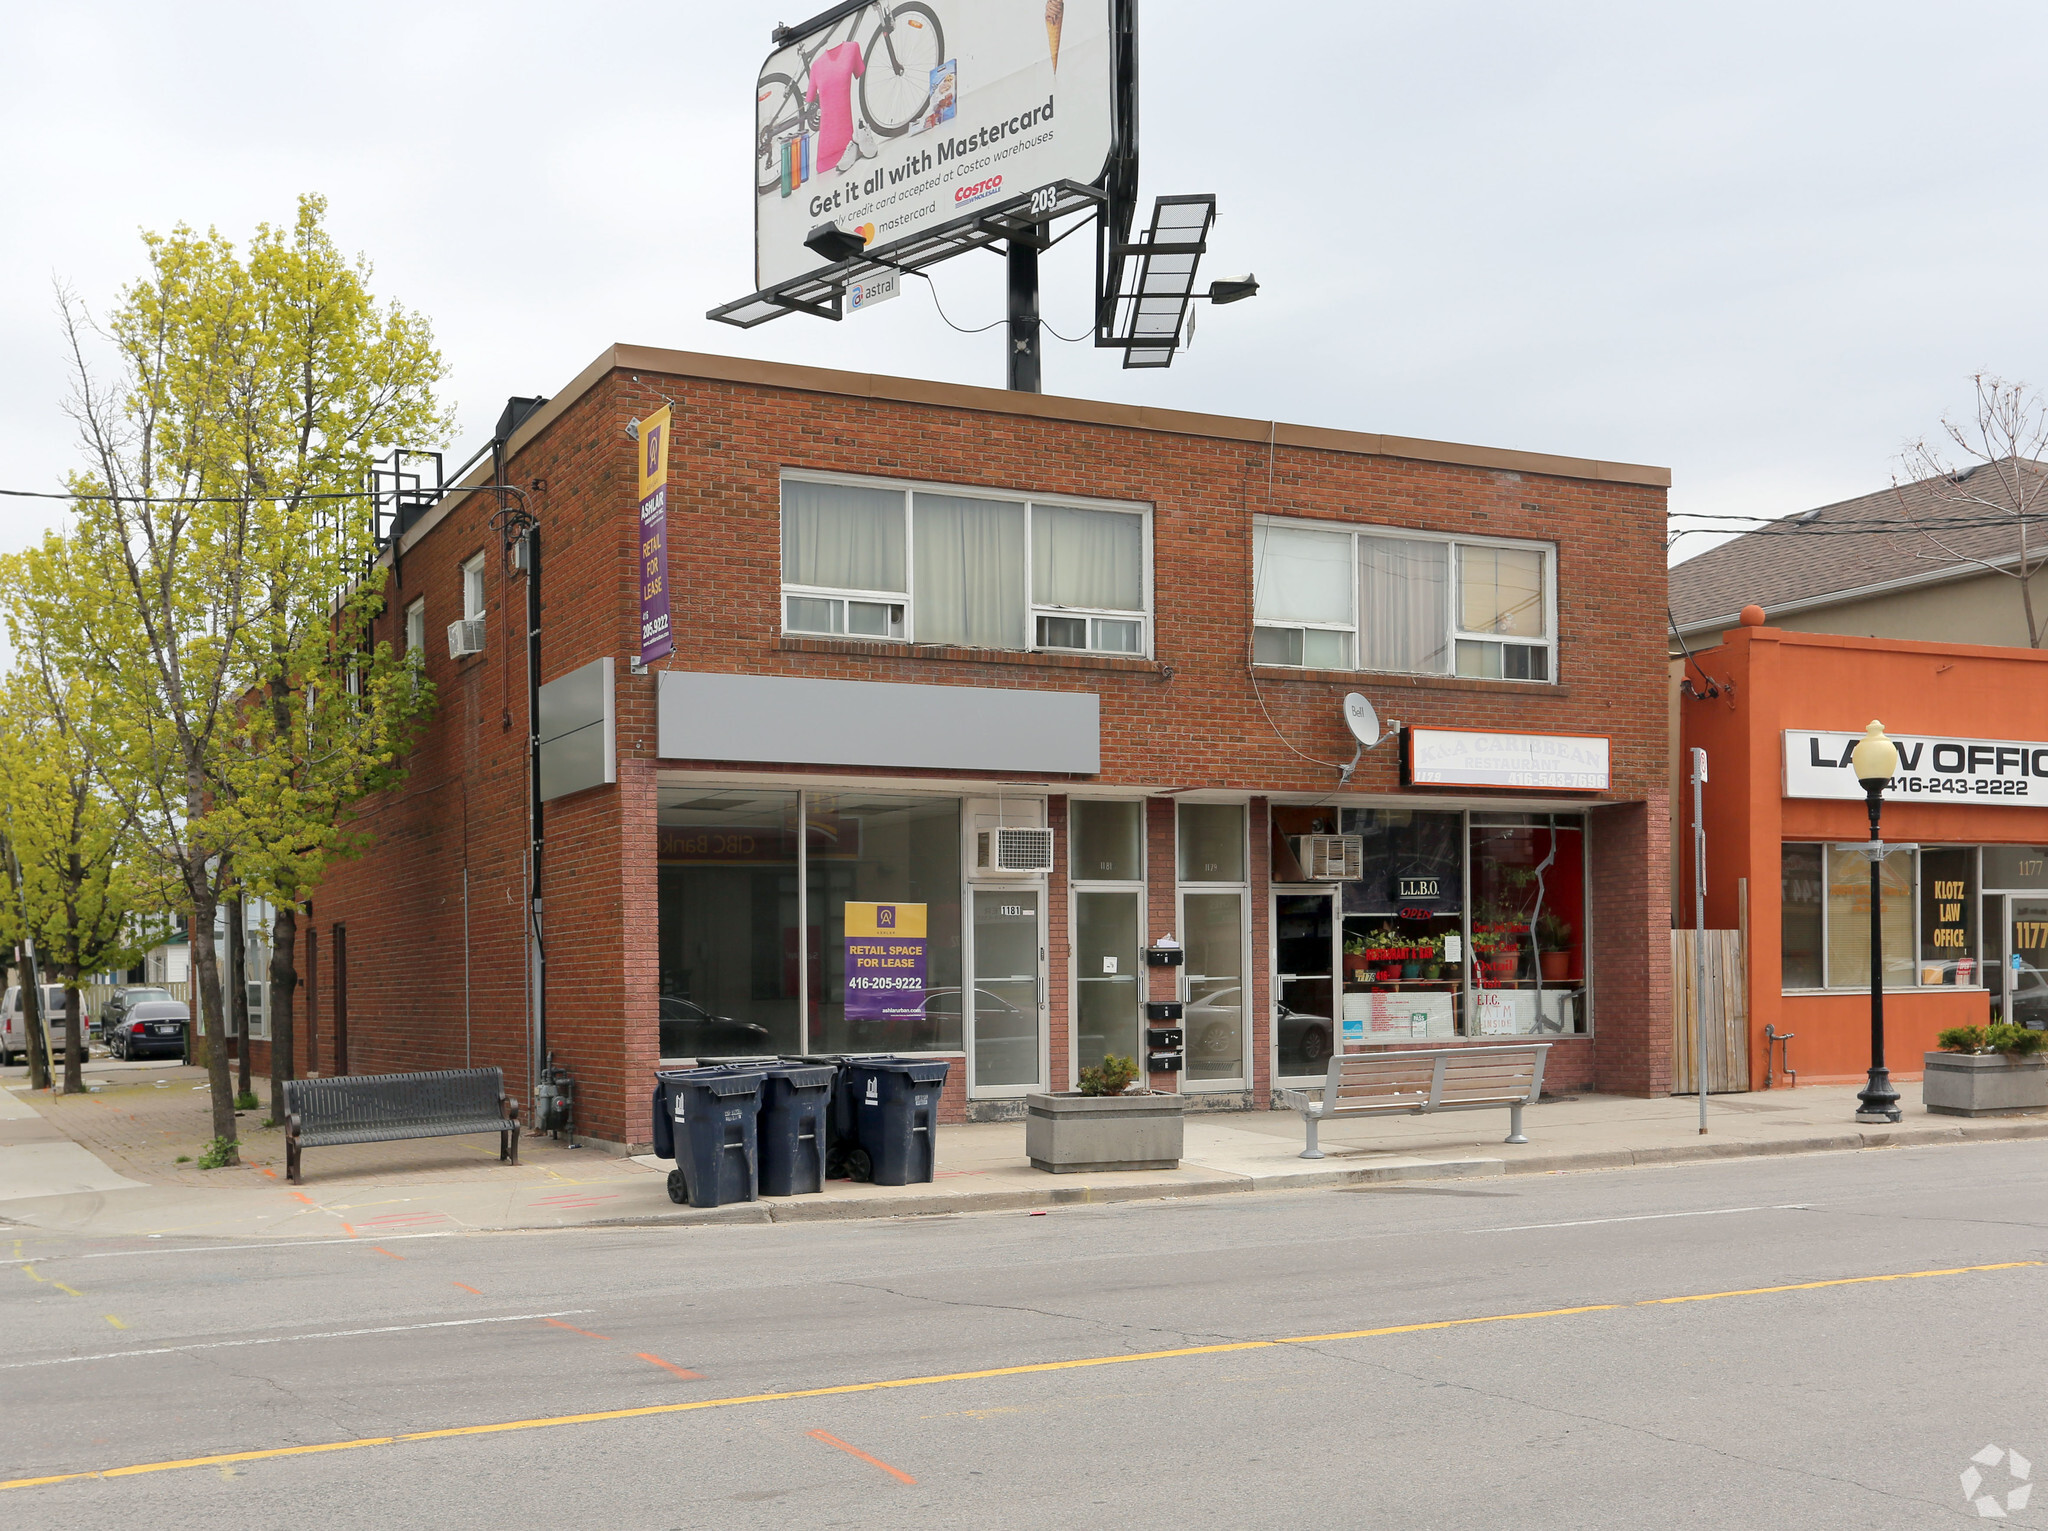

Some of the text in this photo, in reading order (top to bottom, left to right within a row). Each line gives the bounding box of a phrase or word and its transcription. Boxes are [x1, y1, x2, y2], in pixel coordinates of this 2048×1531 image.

[809, 94, 1054, 217] Get it all with Mastercard
[847, 200, 874, 223] credit
[875, 192, 897, 211] card
[898, 173, 941, 202] accepted
[943, 169, 954, 184] at
[956, 156, 991, 177] Costco
[993, 130, 1054, 162] warehouses
[954, 174, 1003, 202] COSTCO
[968, 186, 1002, 204] WHOLESALE
[1030, 186, 1057, 215] 203
[879, 201, 936, 234] mastercard
[865, 276, 894, 299] astral
[640, 490, 664, 521] ASHLAR
[642, 533, 662, 559] RETAIL
[646, 556, 659, 578] FOR
[643, 576, 663, 601] LEASE
[642, 613, 669, 640] 205.9222
[1351, 705, 1365, 718] Bell
[1474, 735, 1601, 769] CARIBBEAN
[1464, 757, 1561, 771] RESTAURANT
[1415, 771, 1606, 788] 1179 416-543-7696
[1886, 776, 2029, 796] 416-243-2222
[2018, 860, 2043, 876] 1177
[1400, 881, 1440, 896] L.L.B.O.
[1934, 881, 1965, 900] KLOTZ
[1002, 906, 1020, 915] 1181
[1400, 907, 1433, 919] OPEN
[1939, 903, 1961, 922] LAW
[1933, 928, 1964, 948] OFFICE
[2016, 921, 2048, 949] 1177
[849, 945, 923, 955] RETAIL SPACE
[1365, 947, 1410, 961] RESTAURANT
[1419, 946, 1434, 959] BAR
[857, 958, 915, 968] FOR LEASE
[1474, 960, 1513, 972] Oxtail
[849, 976, 922, 989] 416-205-9222
[1476, 976, 1502, 989] Fish
[1477, 994, 1500, 1006] E.T.C.
[1483, 1005, 1512, 1018] ATM
